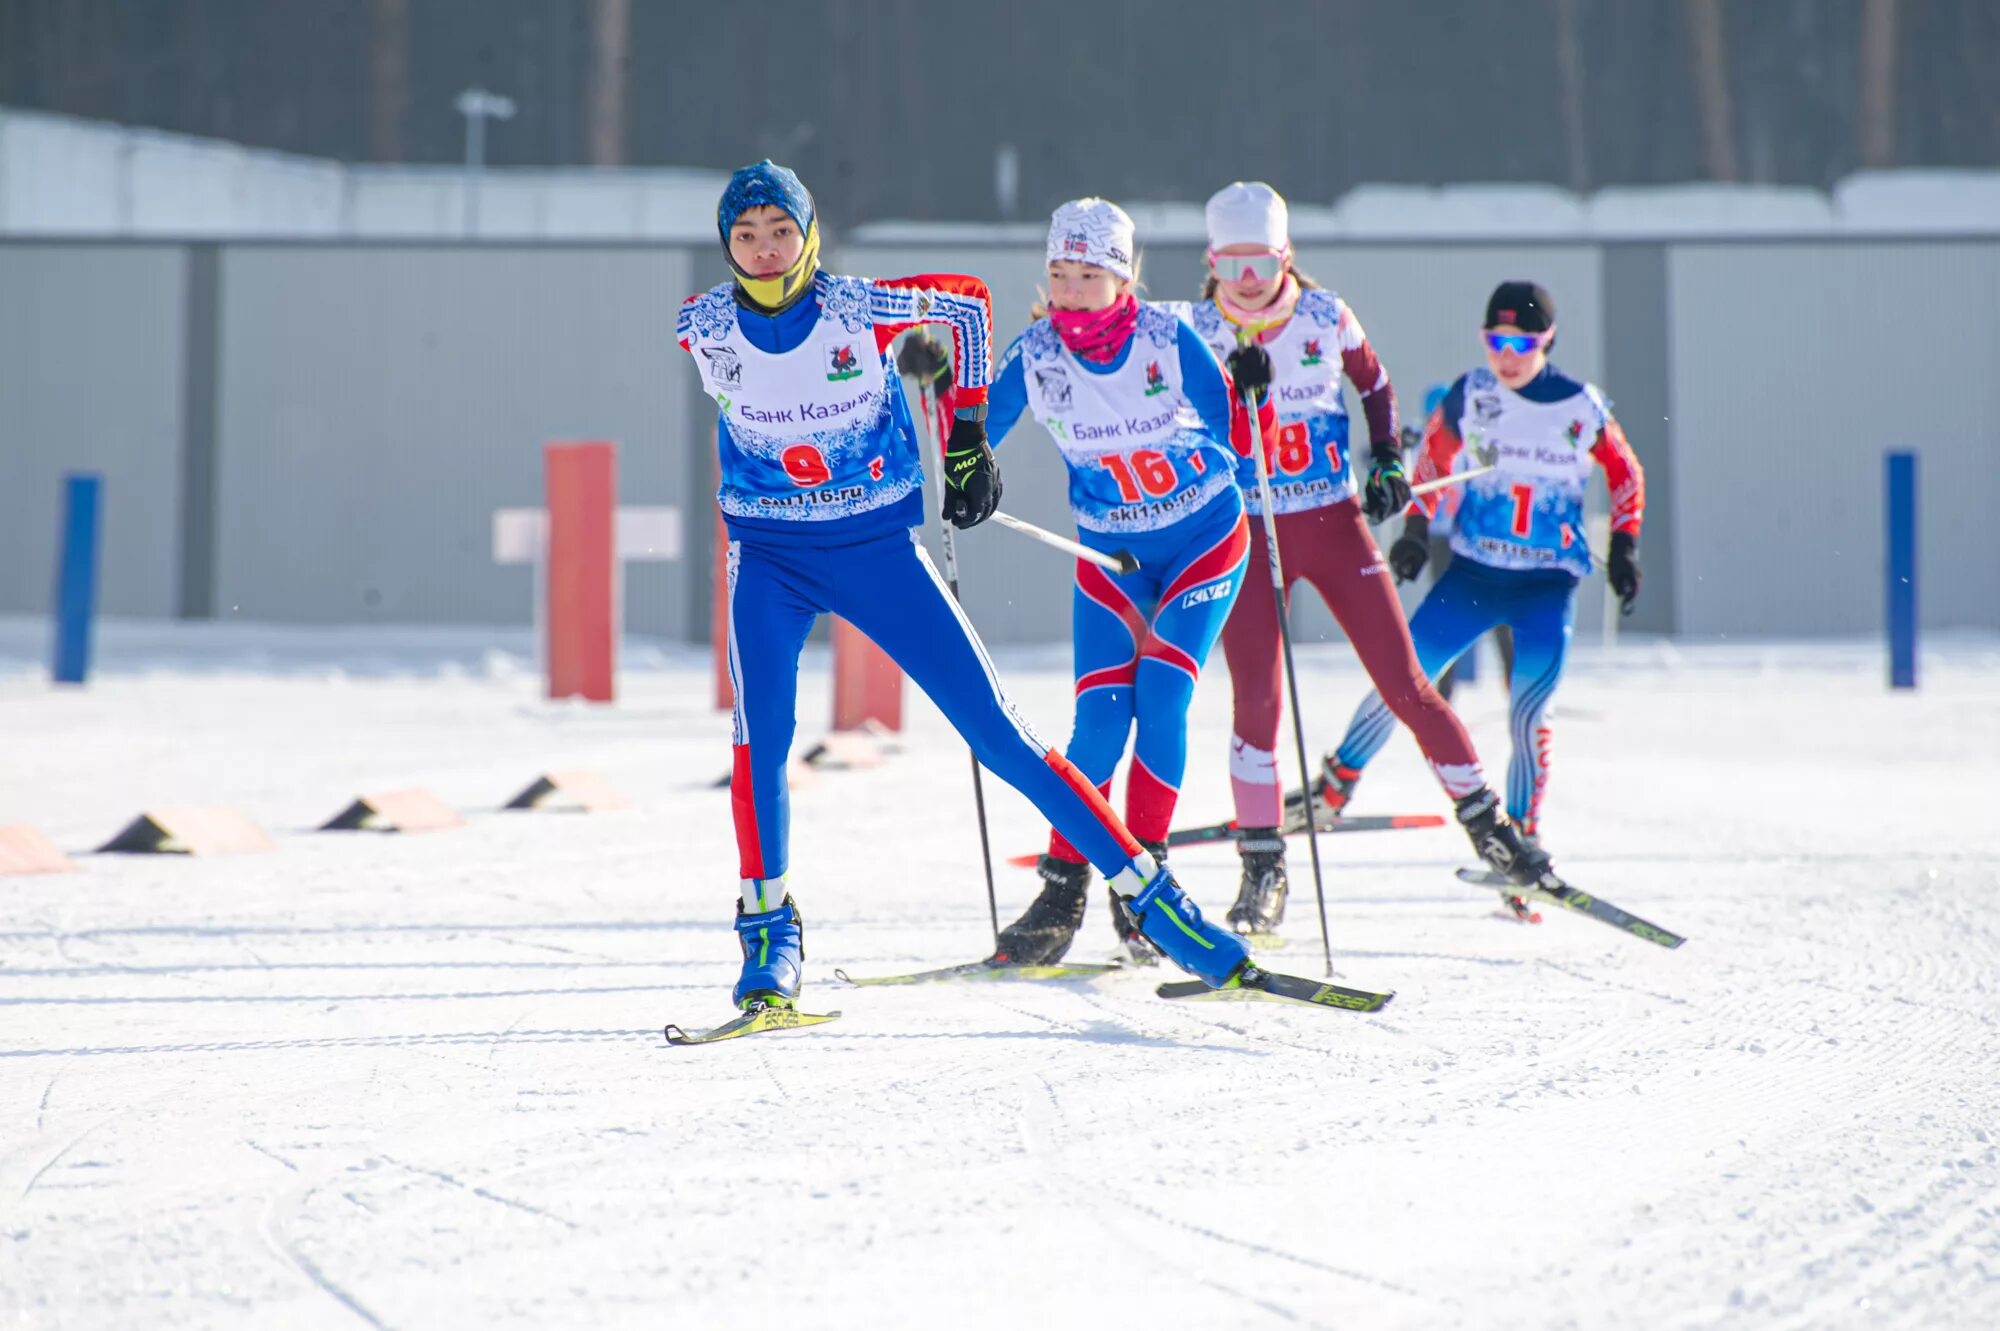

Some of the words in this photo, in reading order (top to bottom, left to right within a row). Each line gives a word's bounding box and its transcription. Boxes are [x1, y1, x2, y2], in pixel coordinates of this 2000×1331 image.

[741, 405, 794, 424] Банк
[1072, 423, 1122, 441] Банк
[780, 443, 832, 488] 9
[1098, 448, 1179, 504] 16
[1109, 486, 1198, 523] ski116.ru
[1246, 481, 1329, 500] sk116.ru
[1511, 481, 1534, 539] 1
